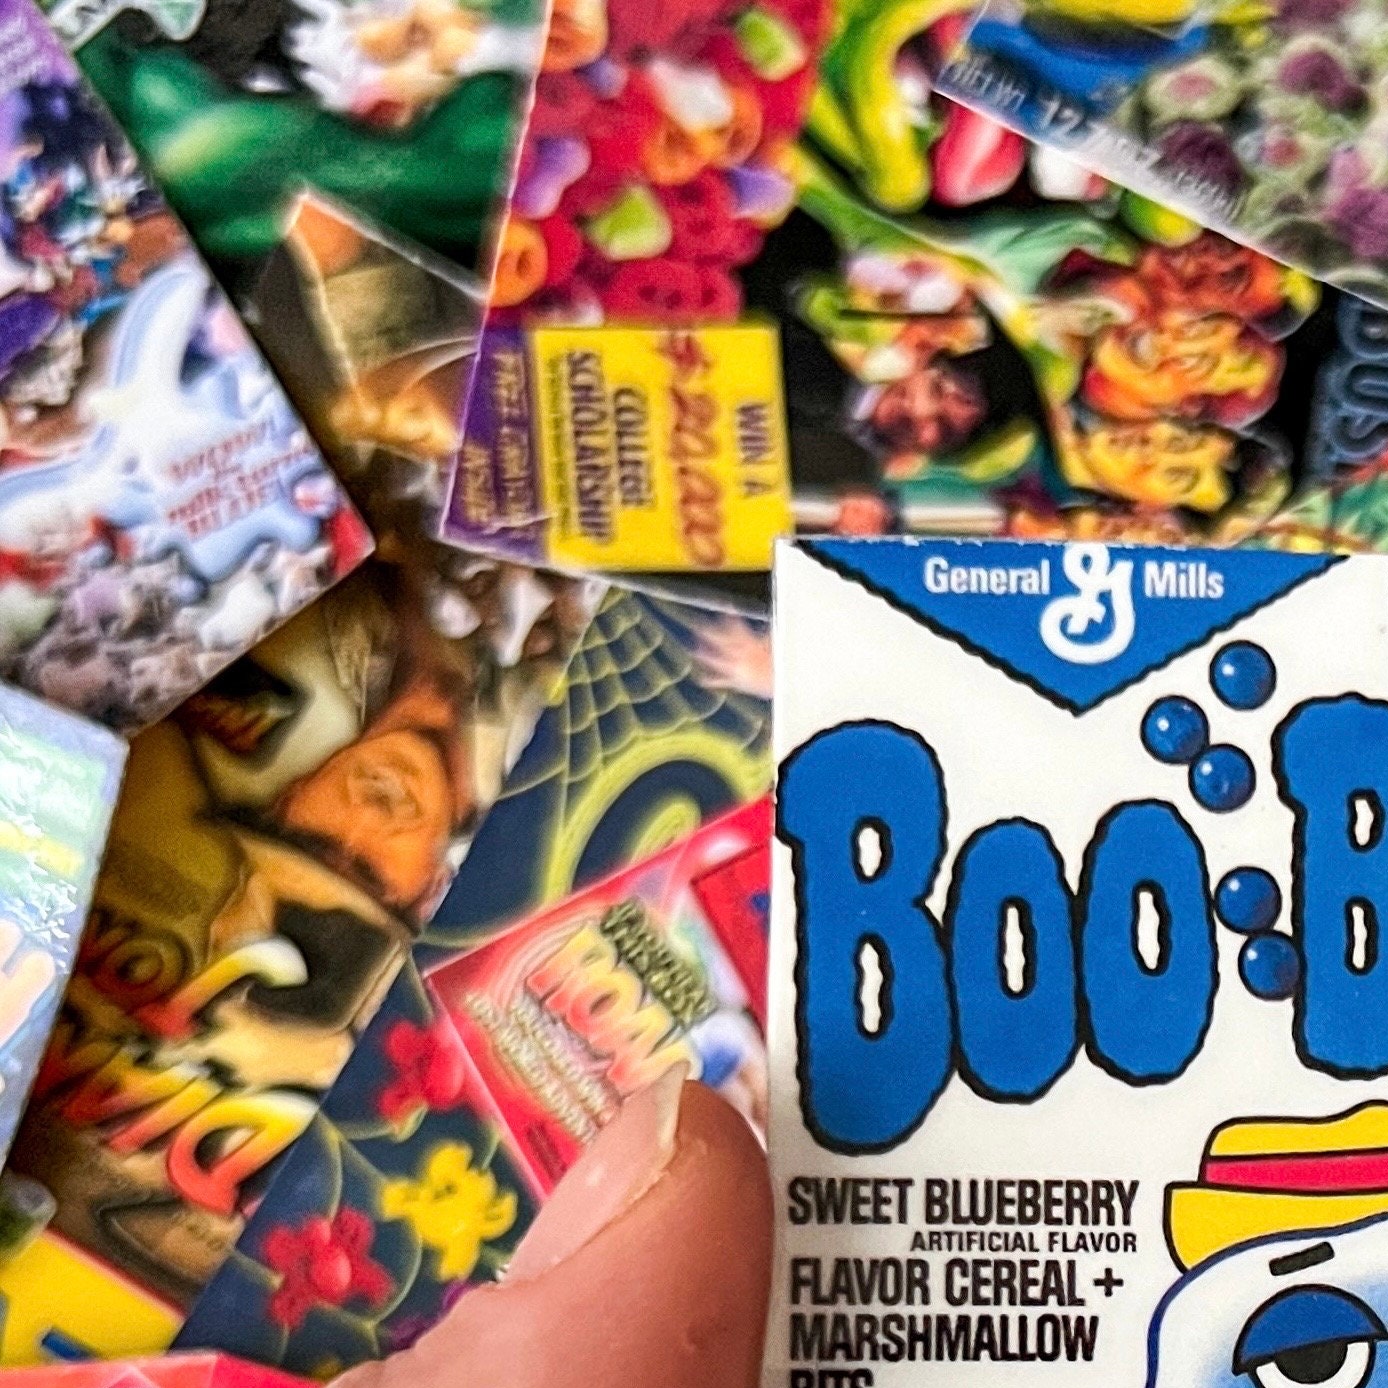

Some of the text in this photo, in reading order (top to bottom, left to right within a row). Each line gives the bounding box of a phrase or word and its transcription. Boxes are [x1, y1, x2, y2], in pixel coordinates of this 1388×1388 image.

[565, 349, 616, 546] SCHOLARSHIP
[611, 384, 656, 508] COLLEGE
[736, 403, 776, 498] WIN A
[923, 557, 1050, 597] General
[1143, 559, 1225, 600] Mills
[775, 718, 1219, 1156] Boo
[787, 1175, 1141, 1227] SWEET BLUEBERRY
[909, 1230, 1139, 1253] ARTIFICIAL FLAVOR
[789, 1257, 931, 1307] FLAVOR
[944, 1257, 1087, 1307] CEREAL
[788, 1312, 1100, 1362] MARSHMALLOW
